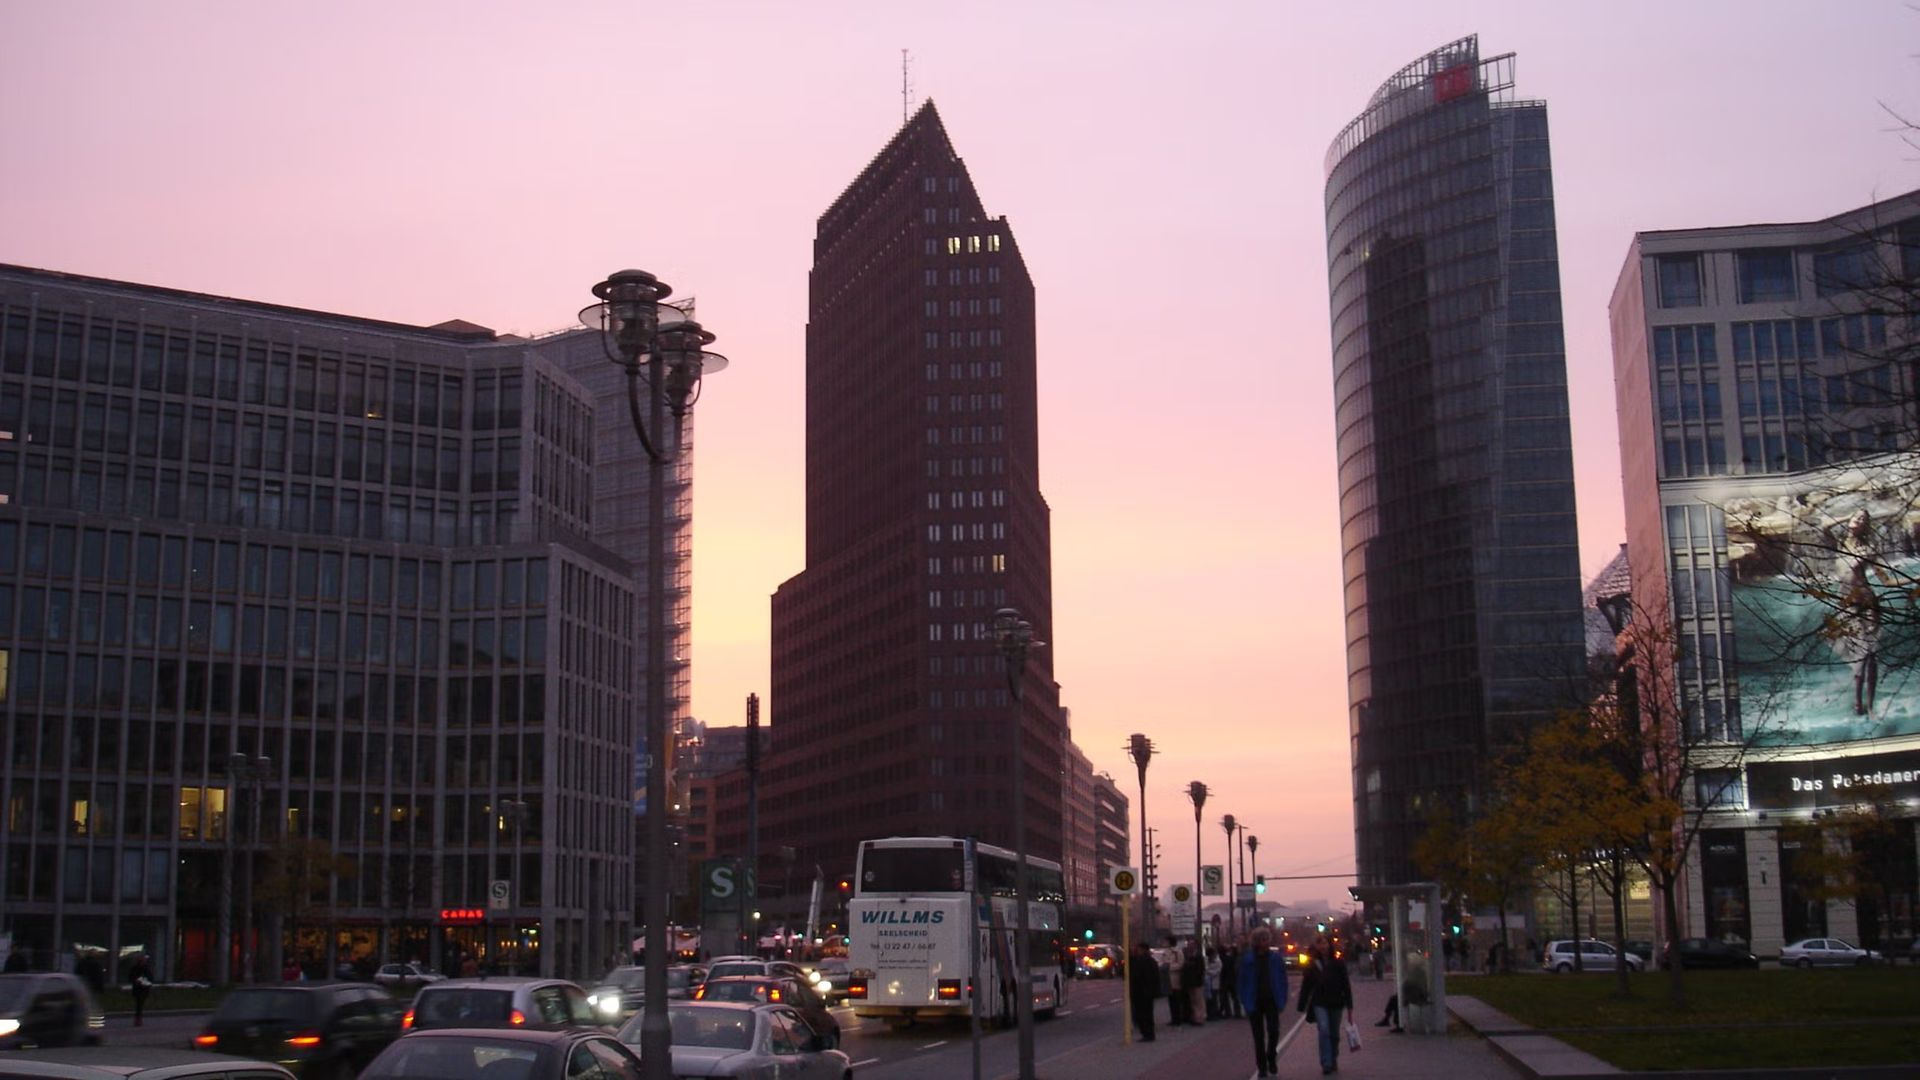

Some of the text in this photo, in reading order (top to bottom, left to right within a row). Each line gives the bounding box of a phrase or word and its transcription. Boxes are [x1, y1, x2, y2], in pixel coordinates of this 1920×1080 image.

[1791, 777, 1823, 791] Das
[711, 867, 734, 897] S
[862, 910, 944, 924] WILLMS
